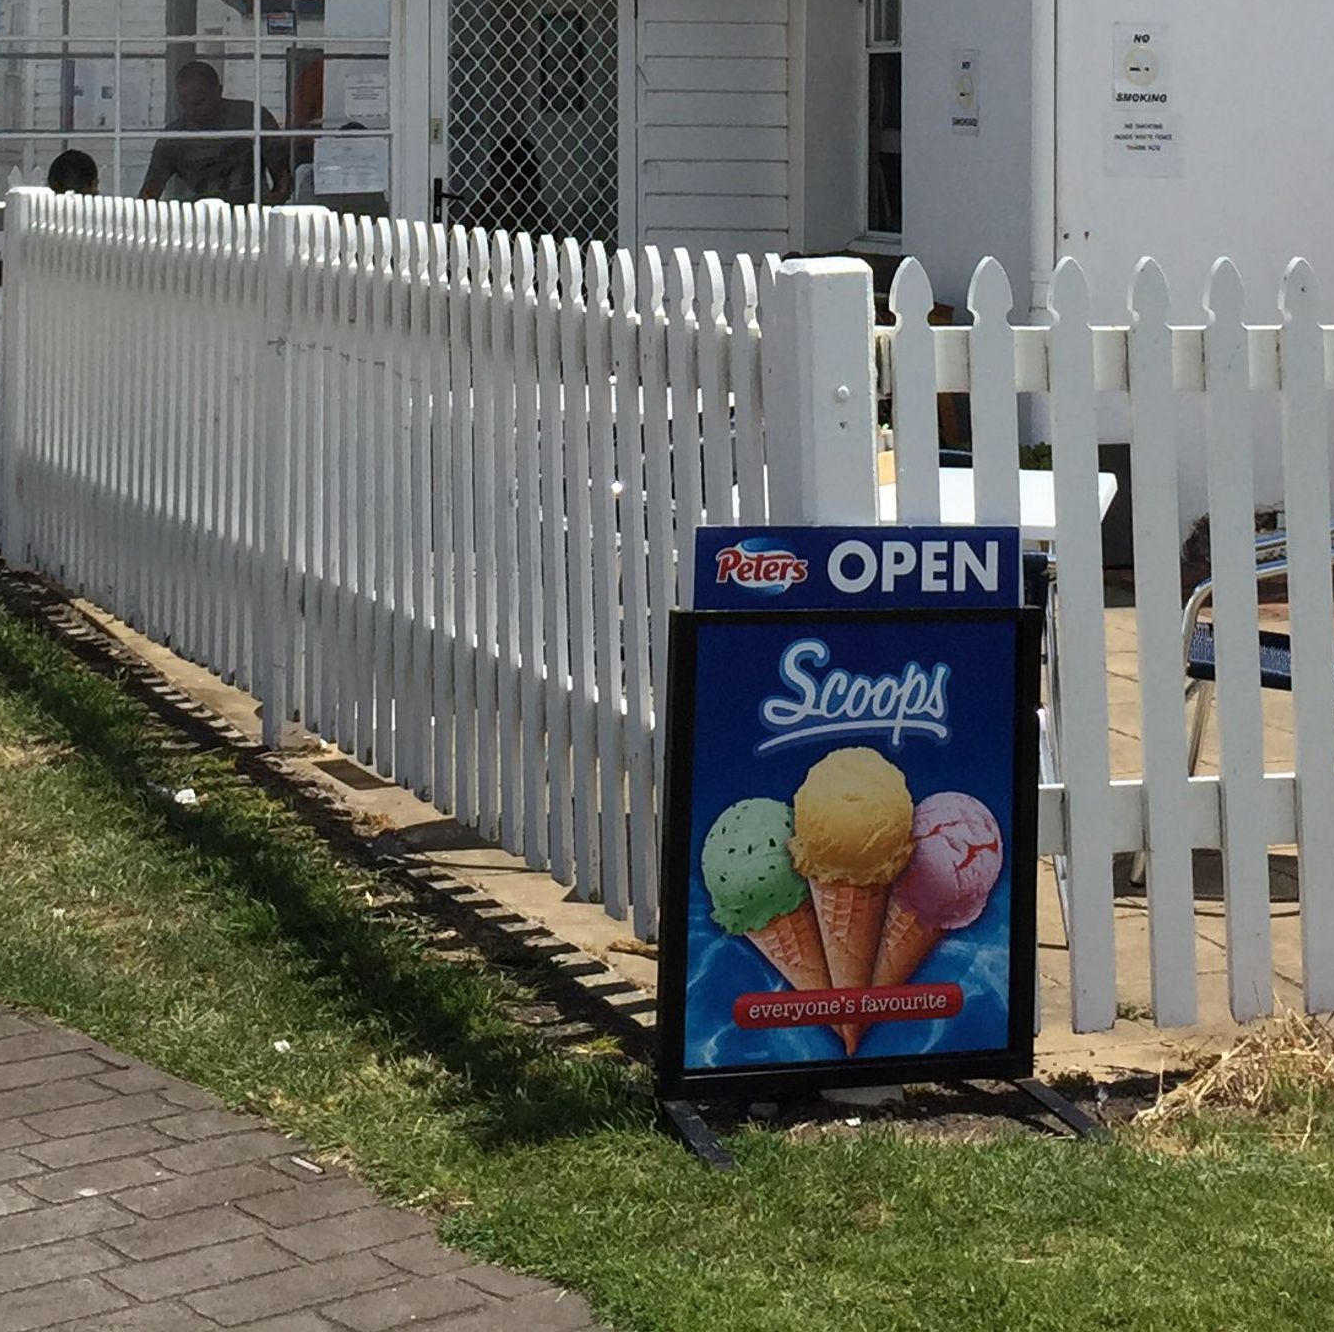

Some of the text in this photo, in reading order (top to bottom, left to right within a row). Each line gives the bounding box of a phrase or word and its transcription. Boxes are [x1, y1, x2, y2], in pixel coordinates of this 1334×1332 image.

[1133, 34, 1150, 43] NO
[1115, 93, 1167, 103] SMOKING
[716, 540, 999, 593] Peters OPEN
[763, 641, 945, 746] Scoops
[749, 993, 948, 1021] everyone's favourite
